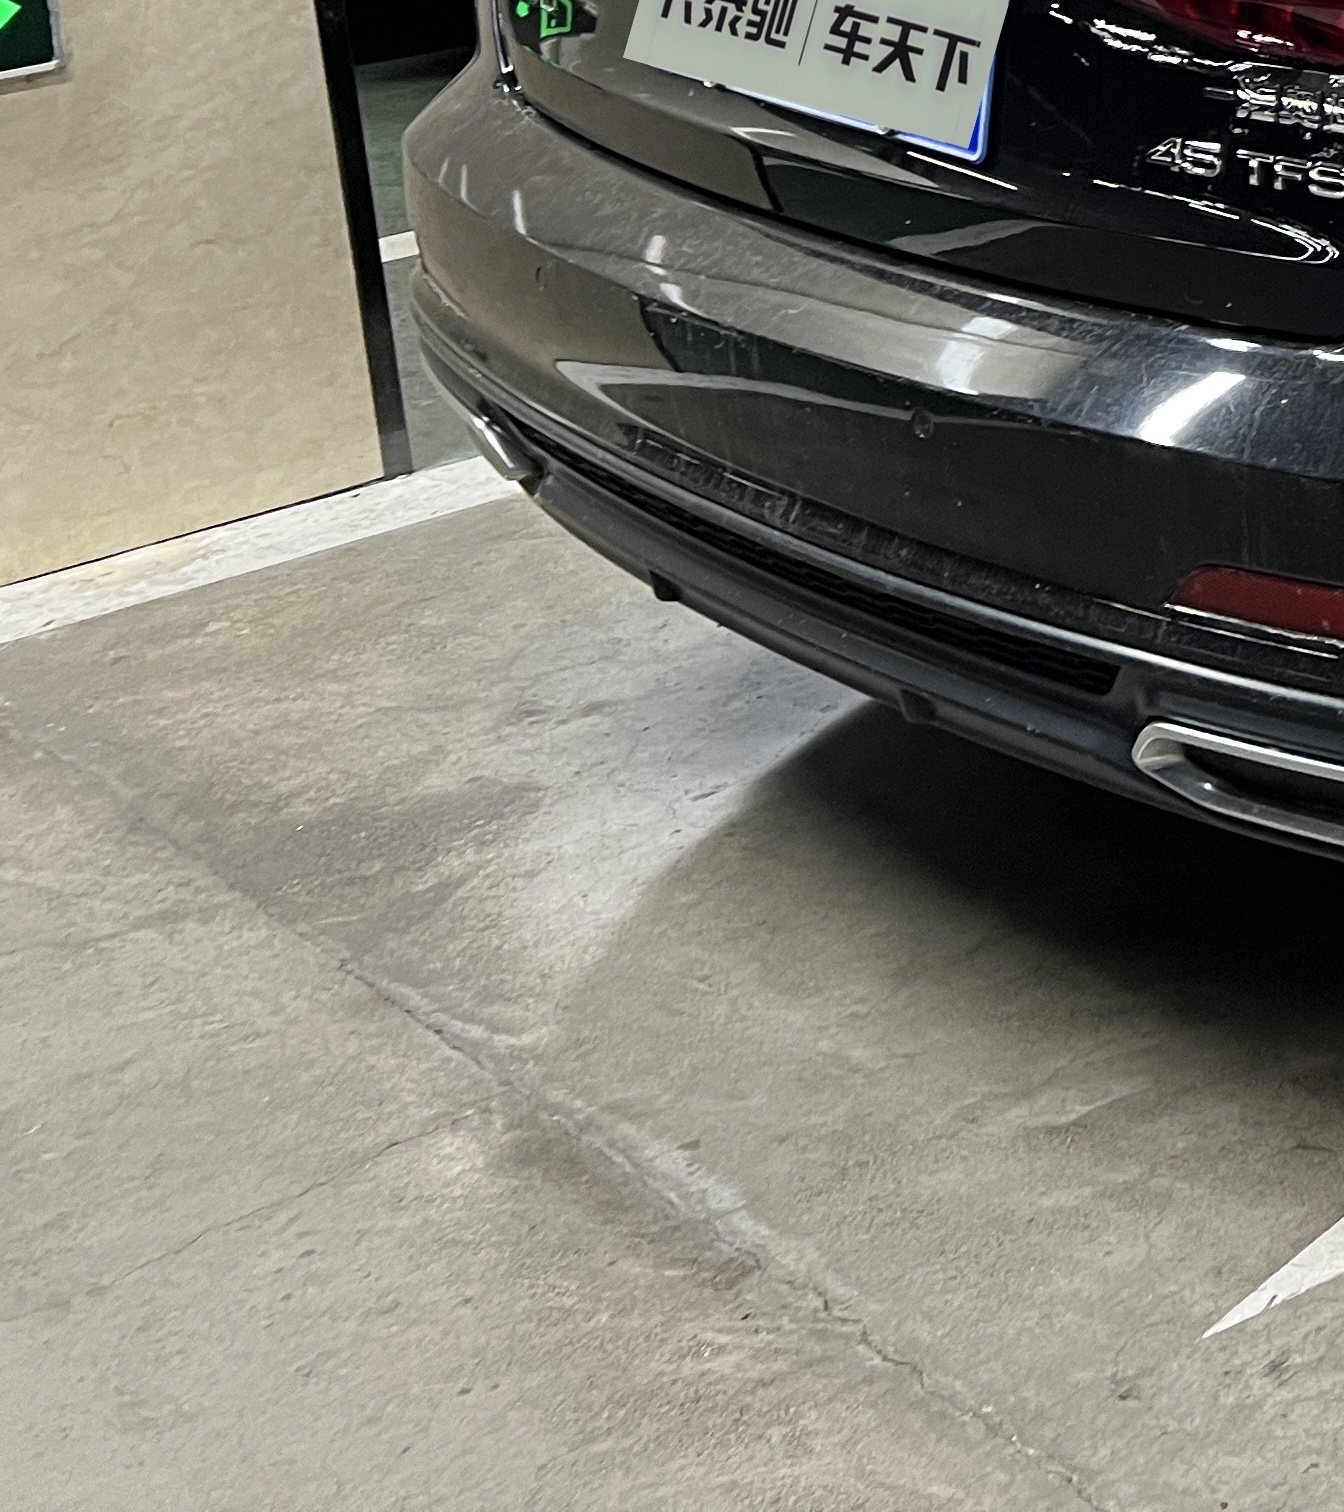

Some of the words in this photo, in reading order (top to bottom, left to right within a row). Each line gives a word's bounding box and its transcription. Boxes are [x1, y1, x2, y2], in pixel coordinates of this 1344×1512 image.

[823, 3, 982, 93] 车天下
[1146, 137, 1223, 178] 45
